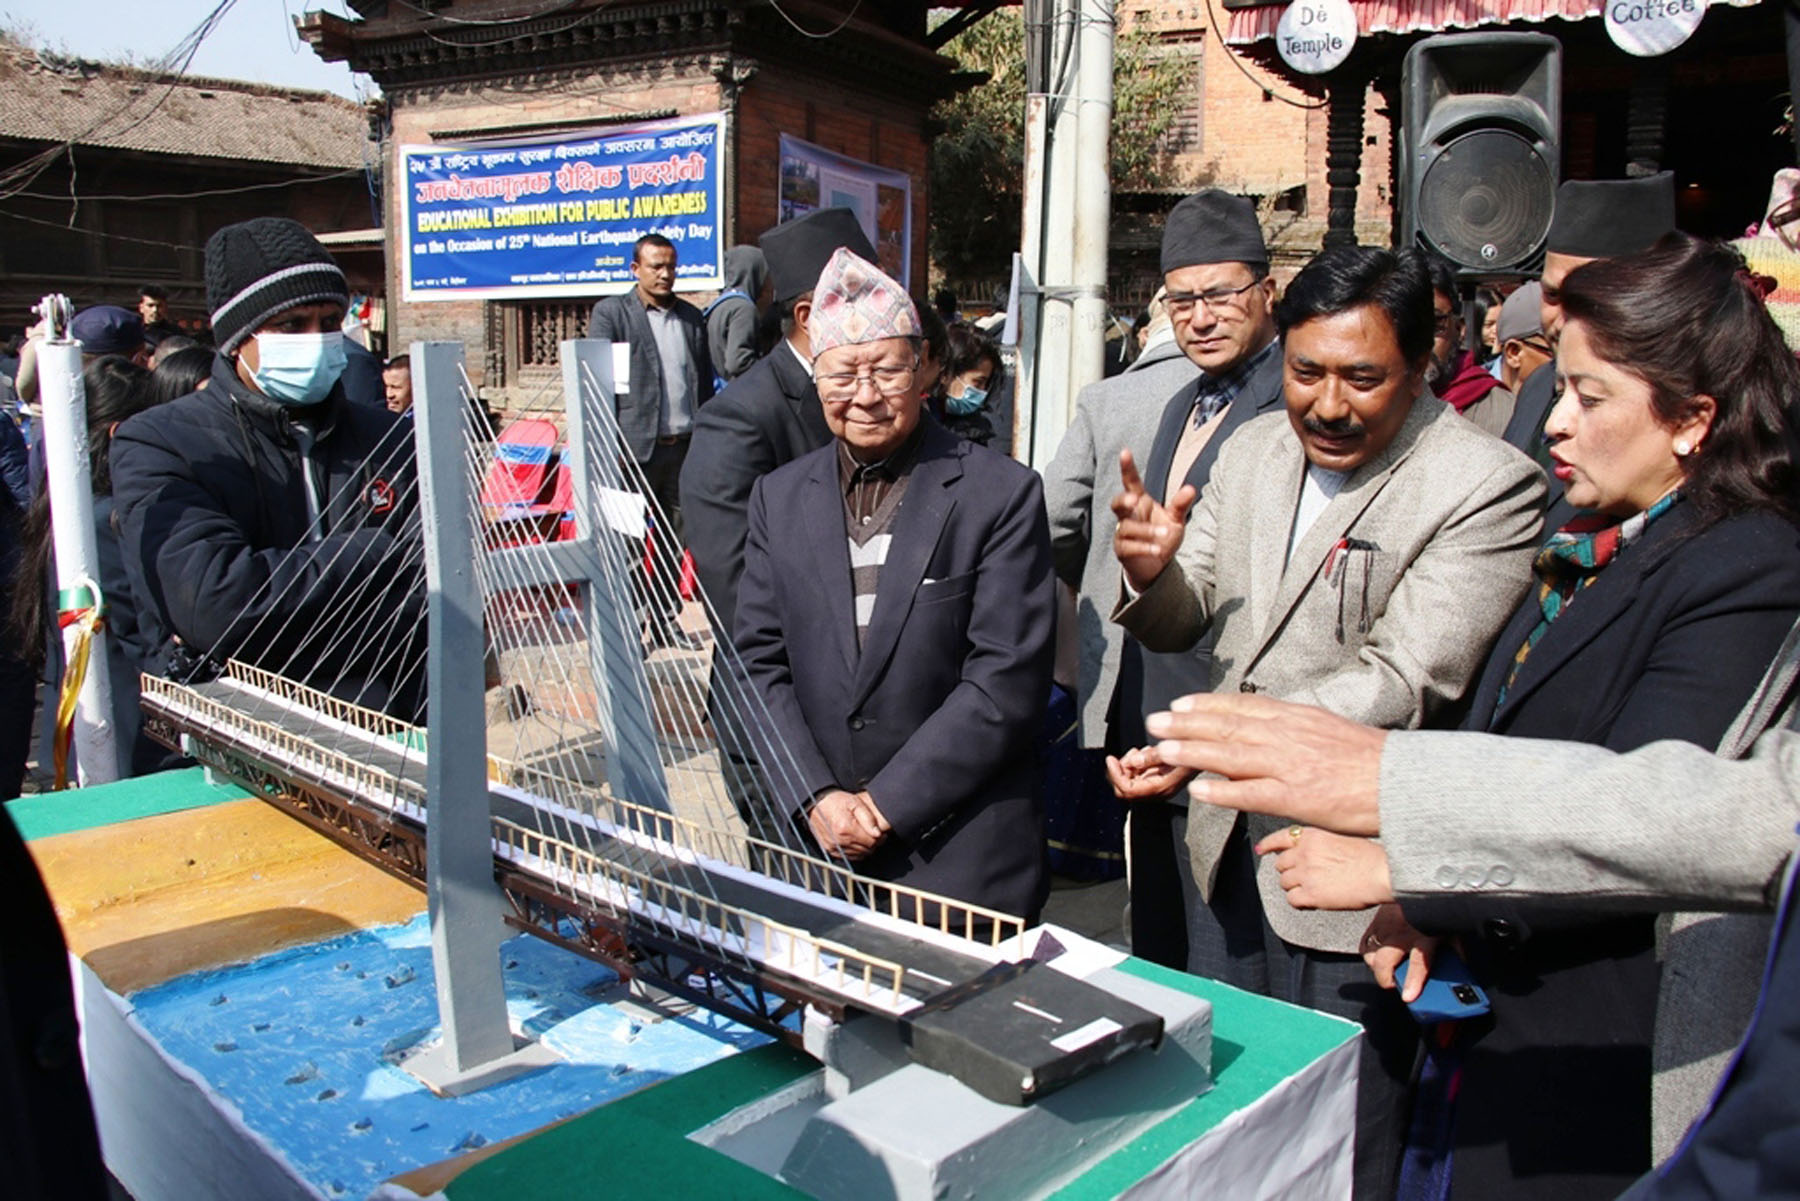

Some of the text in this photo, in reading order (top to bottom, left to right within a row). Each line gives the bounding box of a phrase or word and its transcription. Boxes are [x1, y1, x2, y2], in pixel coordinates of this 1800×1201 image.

[1612, 0, 1695, 24] Coffee
[1283, 33, 1343, 58] Temple
[627, 151, 707, 189] प्रदर्शनी
[418, 191, 707, 232] EDUCATIONAL EXHIBITION FOR PUBLIC AWARENESS
[414, 243, 427, 254] on
[429, 241, 445, 253] the
[447, 237, 493, 252] Occasion
[495, 236, 507, 249] of
[532, 231, 578, 247] National
[688, 222, 712, 240] Day
